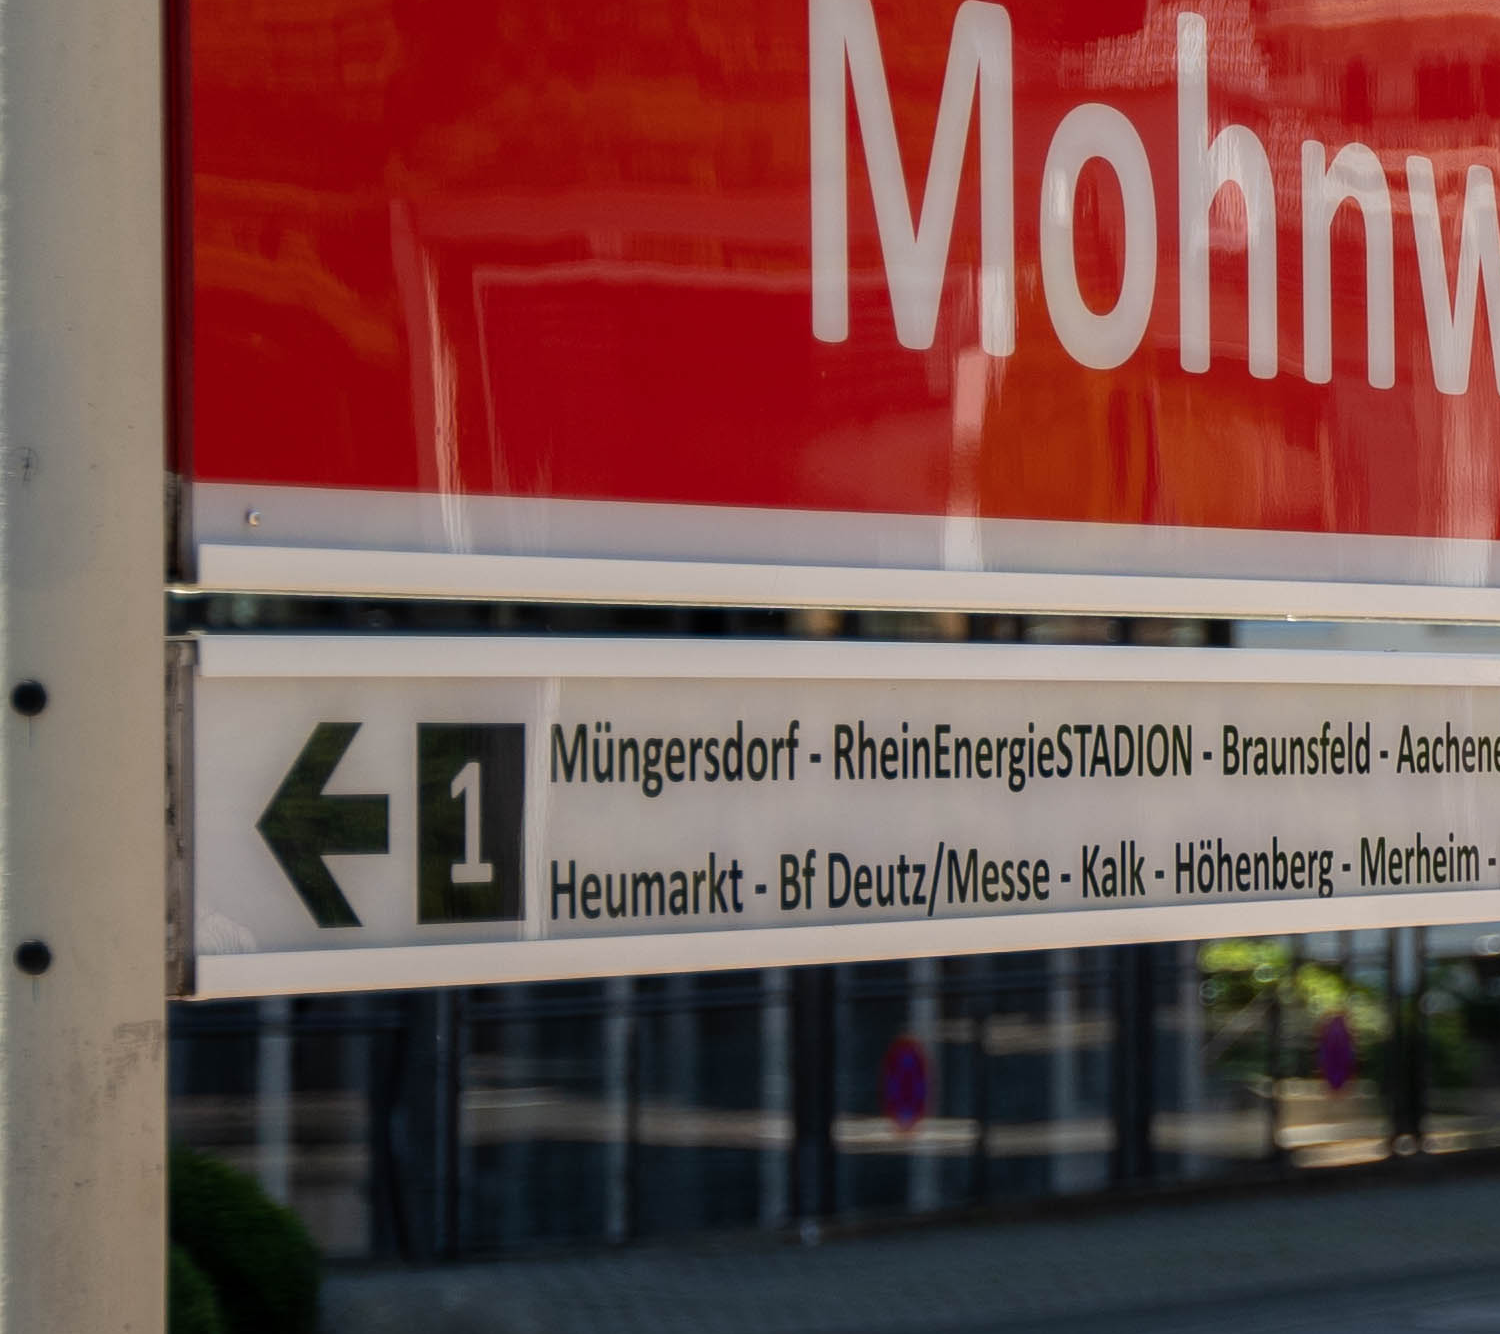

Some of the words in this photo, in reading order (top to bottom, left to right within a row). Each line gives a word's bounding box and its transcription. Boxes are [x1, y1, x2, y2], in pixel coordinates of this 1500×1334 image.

[550, 719, 800, 799] Müngersdorf
[834, 719, 1192, 793] RheinEnergieSTADION
[1222, 721, 1371, 776] Braunsfeld
[450, 761, 493, 884] 1
[550, 851, 744, 921] Heumarkt
[779, 851, 818, 912] Bf
[827, 842, 1050, 917] Deutz/Messe
[1082, 840, 1146, 899] Kalk
[1175, 835, 1334, 899] Höhenberg
[1360, 831, 1480, 887] Merheim
